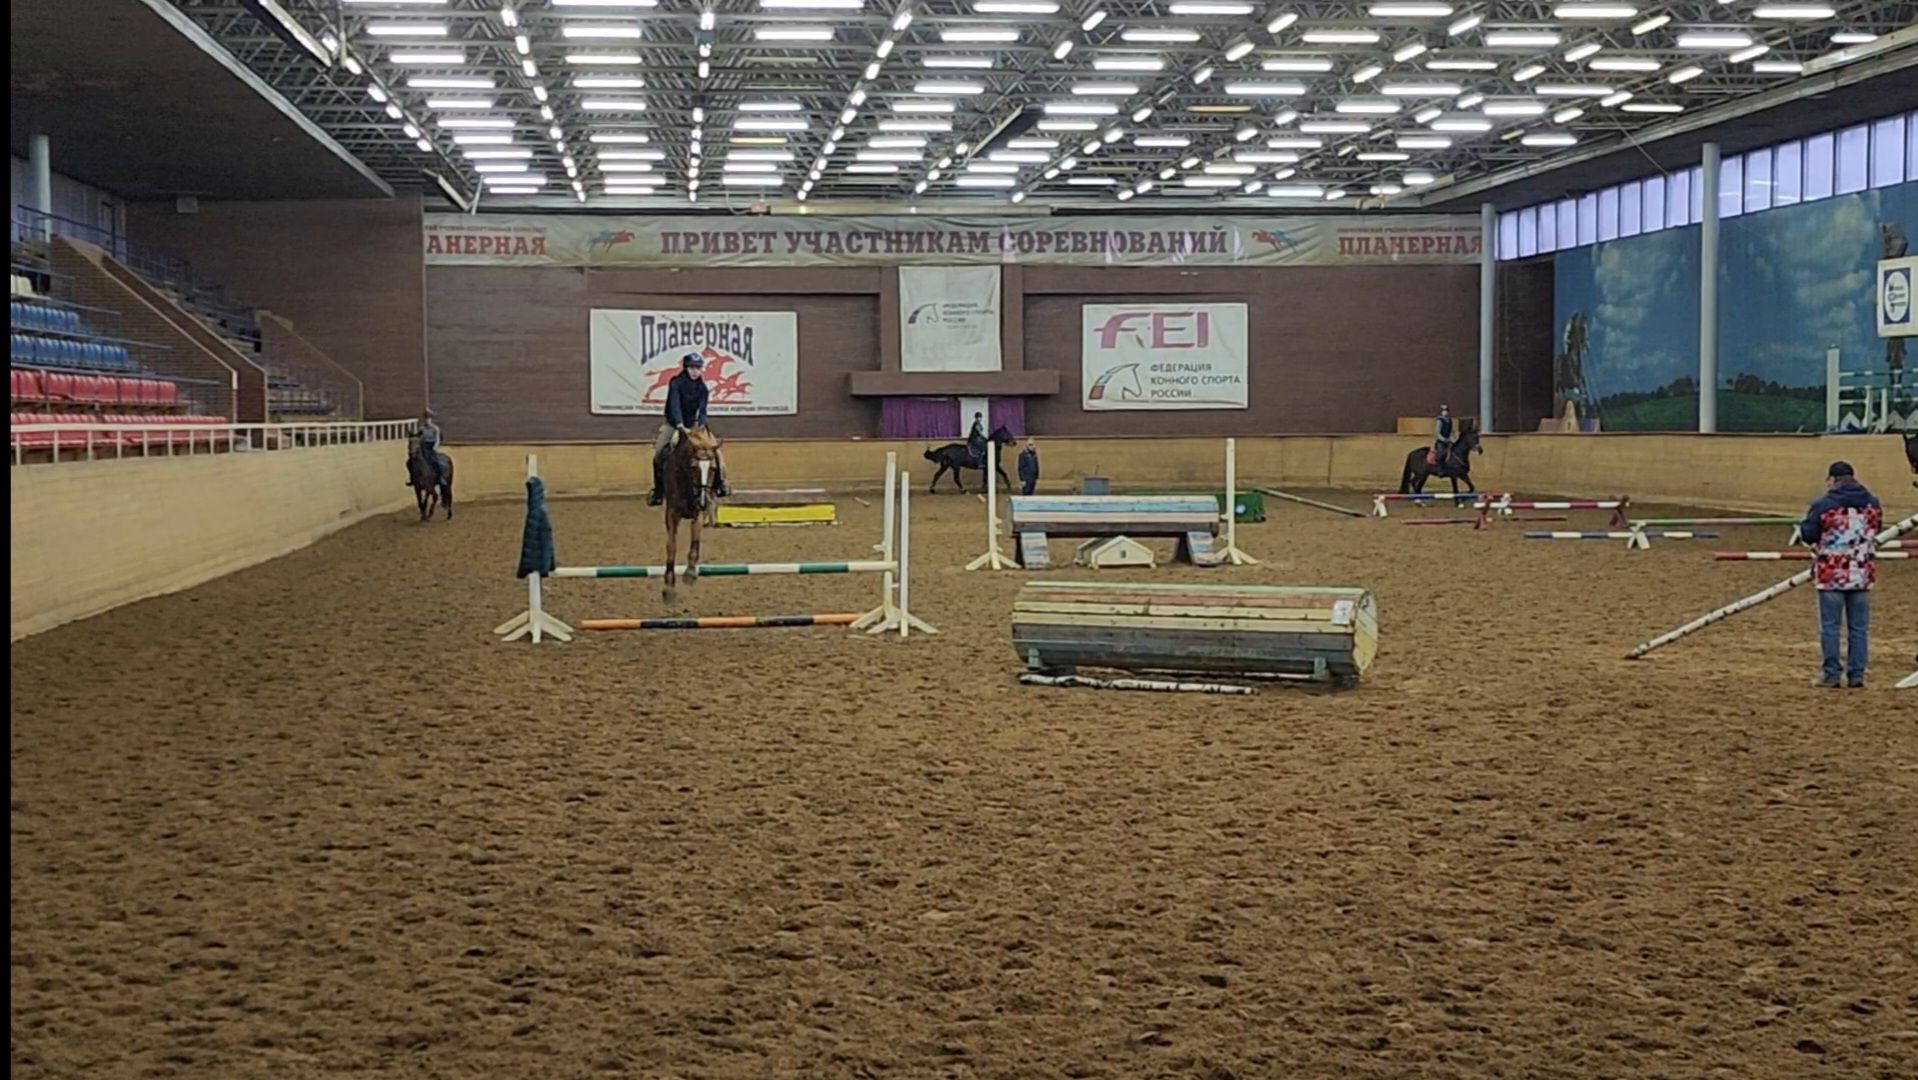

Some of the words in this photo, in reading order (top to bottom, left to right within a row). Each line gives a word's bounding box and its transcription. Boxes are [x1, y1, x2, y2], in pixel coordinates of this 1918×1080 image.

[426, 234, 547, 255] АНЕРНАЯ
[660, 231, 777, 254] ПРИВЕТ
[784, 231, 991, 254] УЧАСТНИКАМ
[998, 225, 1228, 254] СОРЕВНОВАНИЙ
[1338, 234, 1482, 256] ПЛАНЕРНАЯ
[1093, 311, 1209, 349] FEI
[640, 315, 754, 367] Планерная
[1150, 363, 1212, 373] ФЕДЕРАЦИЯ
[1150, 375, 1198, 385] КОННОГО
[1201, 375, 1240, 385] СПОРТА
[1150, 388, 1192, 398] РОССИИ
